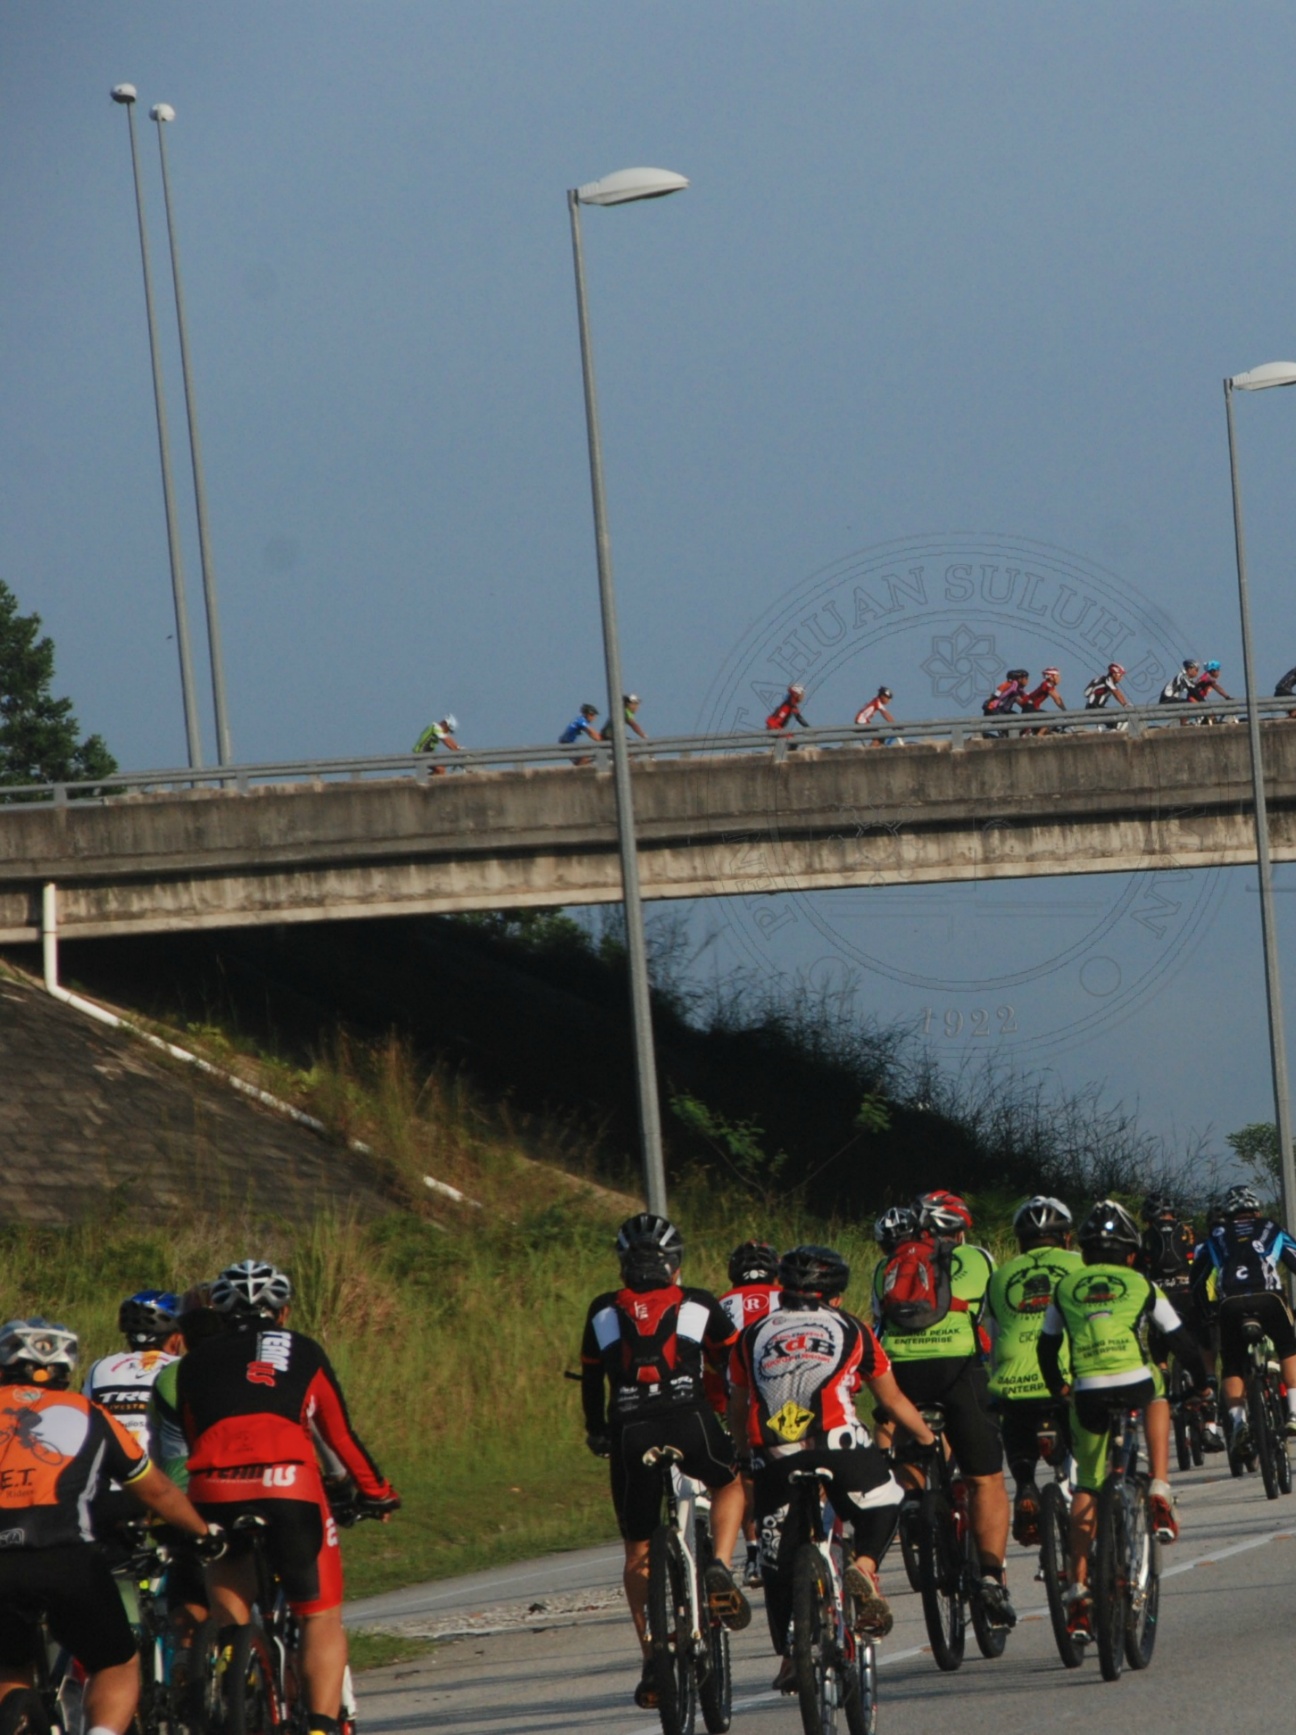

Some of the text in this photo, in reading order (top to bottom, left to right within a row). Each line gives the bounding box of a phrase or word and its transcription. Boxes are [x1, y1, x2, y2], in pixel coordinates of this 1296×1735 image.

[894, 1335, 953, 1344] ENTERPRISE
[1002, 1382, 1045, 1395] ENTERP
[99, 1390, 152, 1403] TRE
